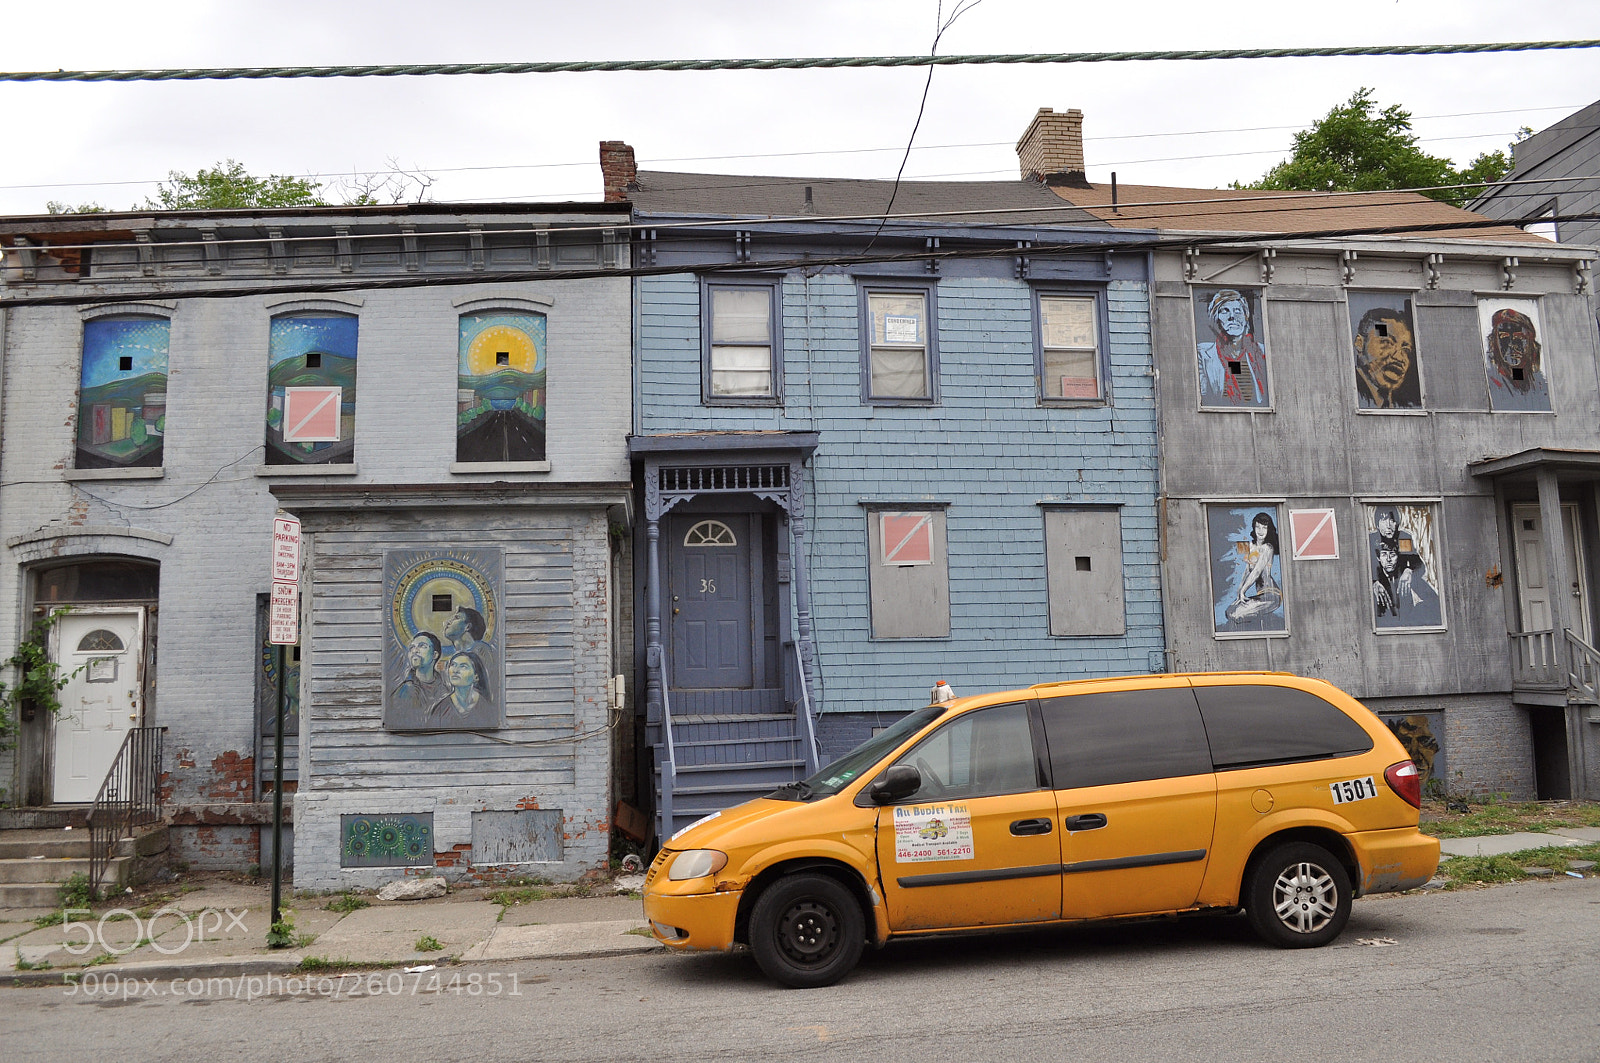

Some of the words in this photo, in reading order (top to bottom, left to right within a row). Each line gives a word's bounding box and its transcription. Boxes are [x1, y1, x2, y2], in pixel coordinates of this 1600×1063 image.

[283, 523, 292, 532] NO
[275, 533, 298, 543] PARKING
[700, 579, 716, 593] 36
[277, 586, 292, 596] SNOW
[272, 597, 297, 606] EMERGENCY
[1332, 777, 1377, 803] 1501
[898, 849, 932, 858] 446-2400
[937, 847, 971, 856] 561-2210
